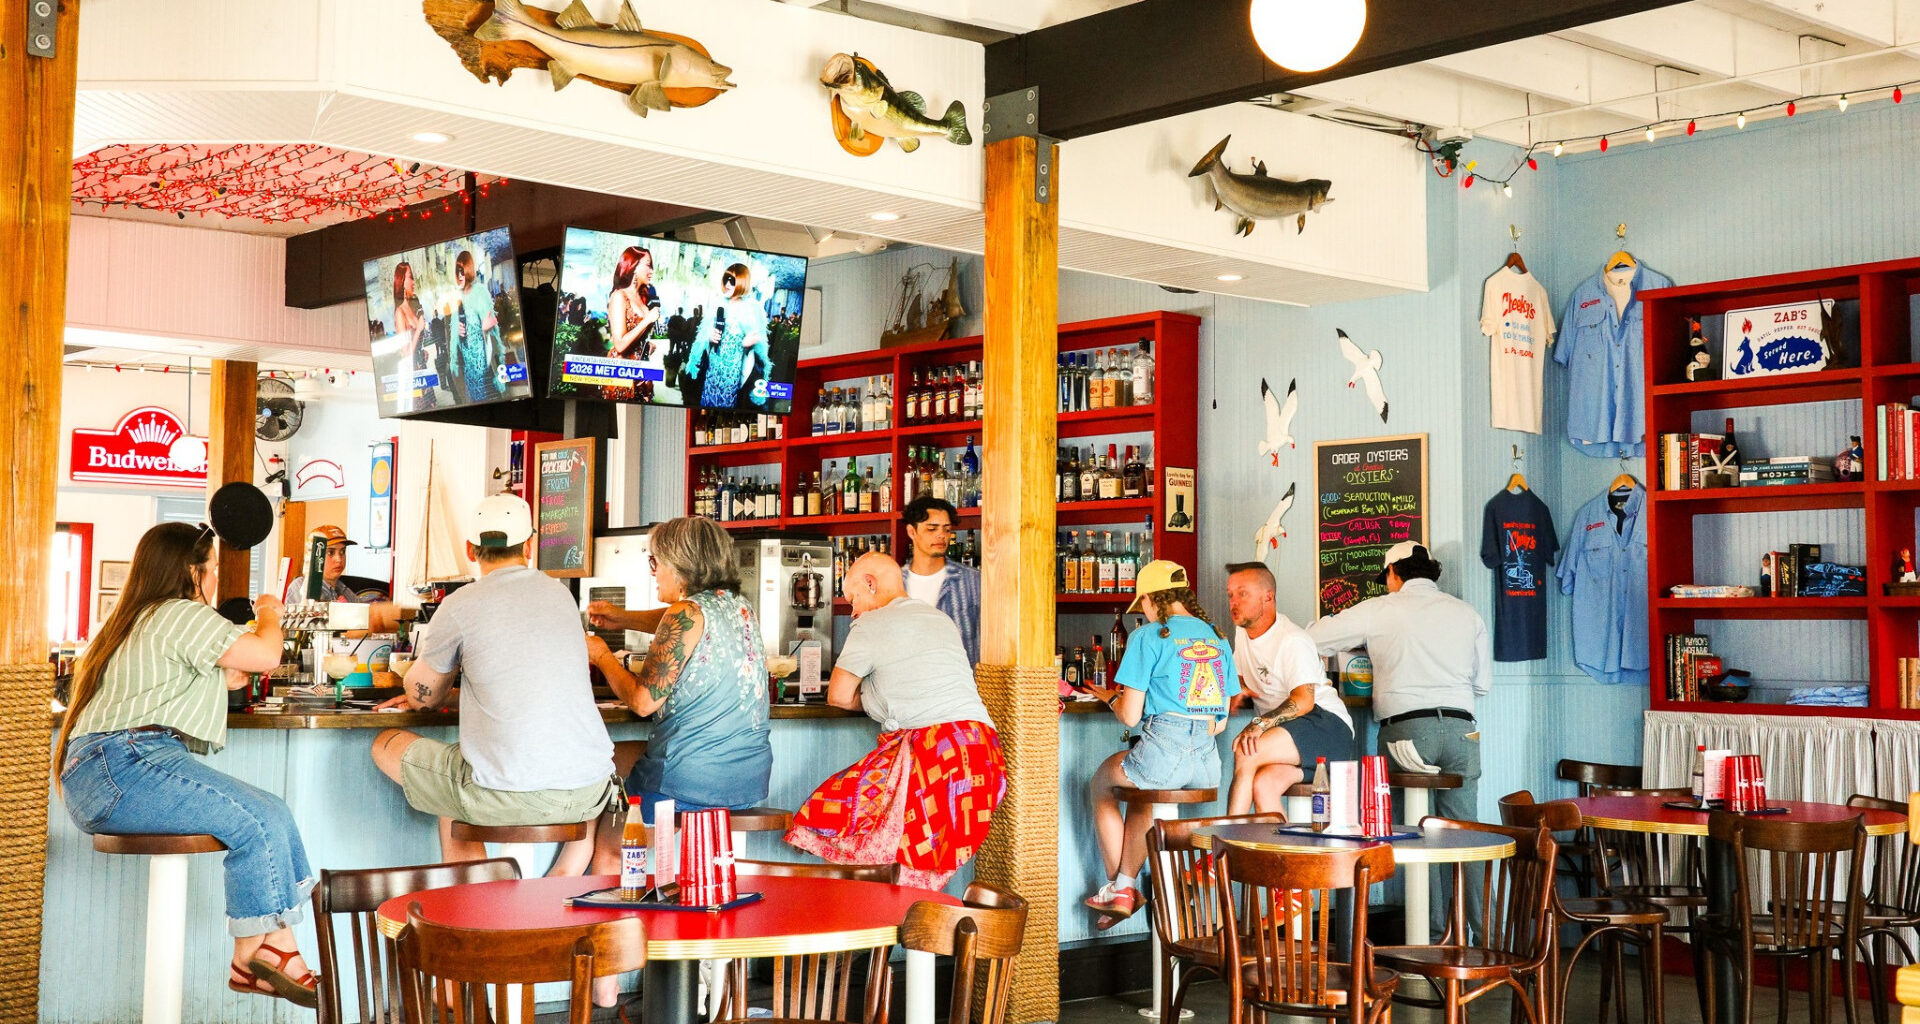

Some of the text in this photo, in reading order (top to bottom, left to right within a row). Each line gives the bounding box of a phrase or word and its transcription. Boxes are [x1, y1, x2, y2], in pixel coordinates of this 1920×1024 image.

[1502, 292, 1536, 319] Cheeky's
[1774, 310, 1807, 323] ZAB'S
[1808, 327, 1821, 335] SAUC
[1764, 341, 1787, 359] Served
[1779, 350, 1814, 365] Here.
[570, 363, 644, 378] 2026 MET GALA
[753, 379, 770, 397] 8
[1332, 449, 1408, 465] ORDER OYSTERS
[1691, 440, 1699, 488] WINE BIBLE
[1346, 469, 1393, 483] OYSTERS
[1343, 492, 1391, 502] SEADUCTION
[1349, 521, 1381, 531] CALUSA
[1323, 584, 1342, 599] FRESH
[627, 851, 646, 859] ZAB'S
